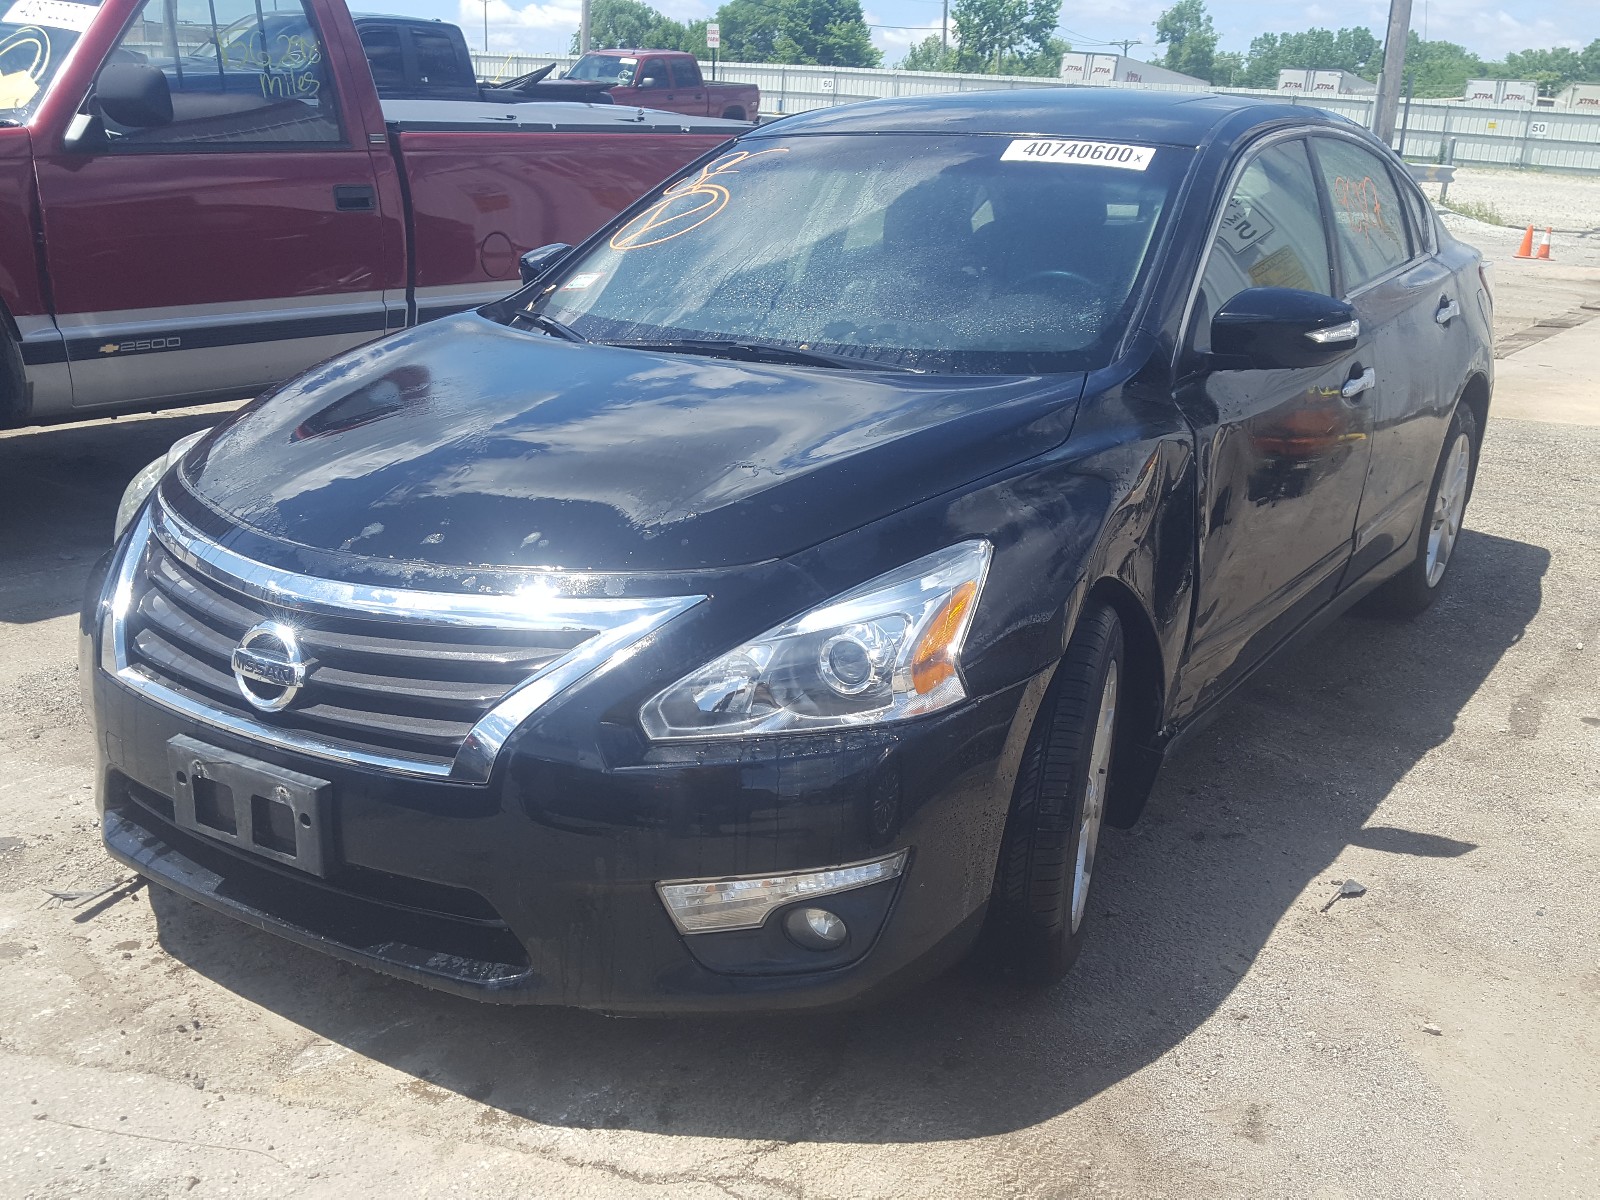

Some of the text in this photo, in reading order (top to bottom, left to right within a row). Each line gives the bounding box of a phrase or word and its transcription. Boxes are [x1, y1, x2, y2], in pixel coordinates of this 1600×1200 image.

[823, 80, 833, 88] 60
[1282, 81, 1303, 89] XTRA
[1576, 98, 1599, 106] XTRA
[1532, 123, 1546, 133] 50
[1023, 142, 1134, 163] 40740600
[120, 337, 181, 352] 2500
[234, 652, 294, 686] NISSAN
